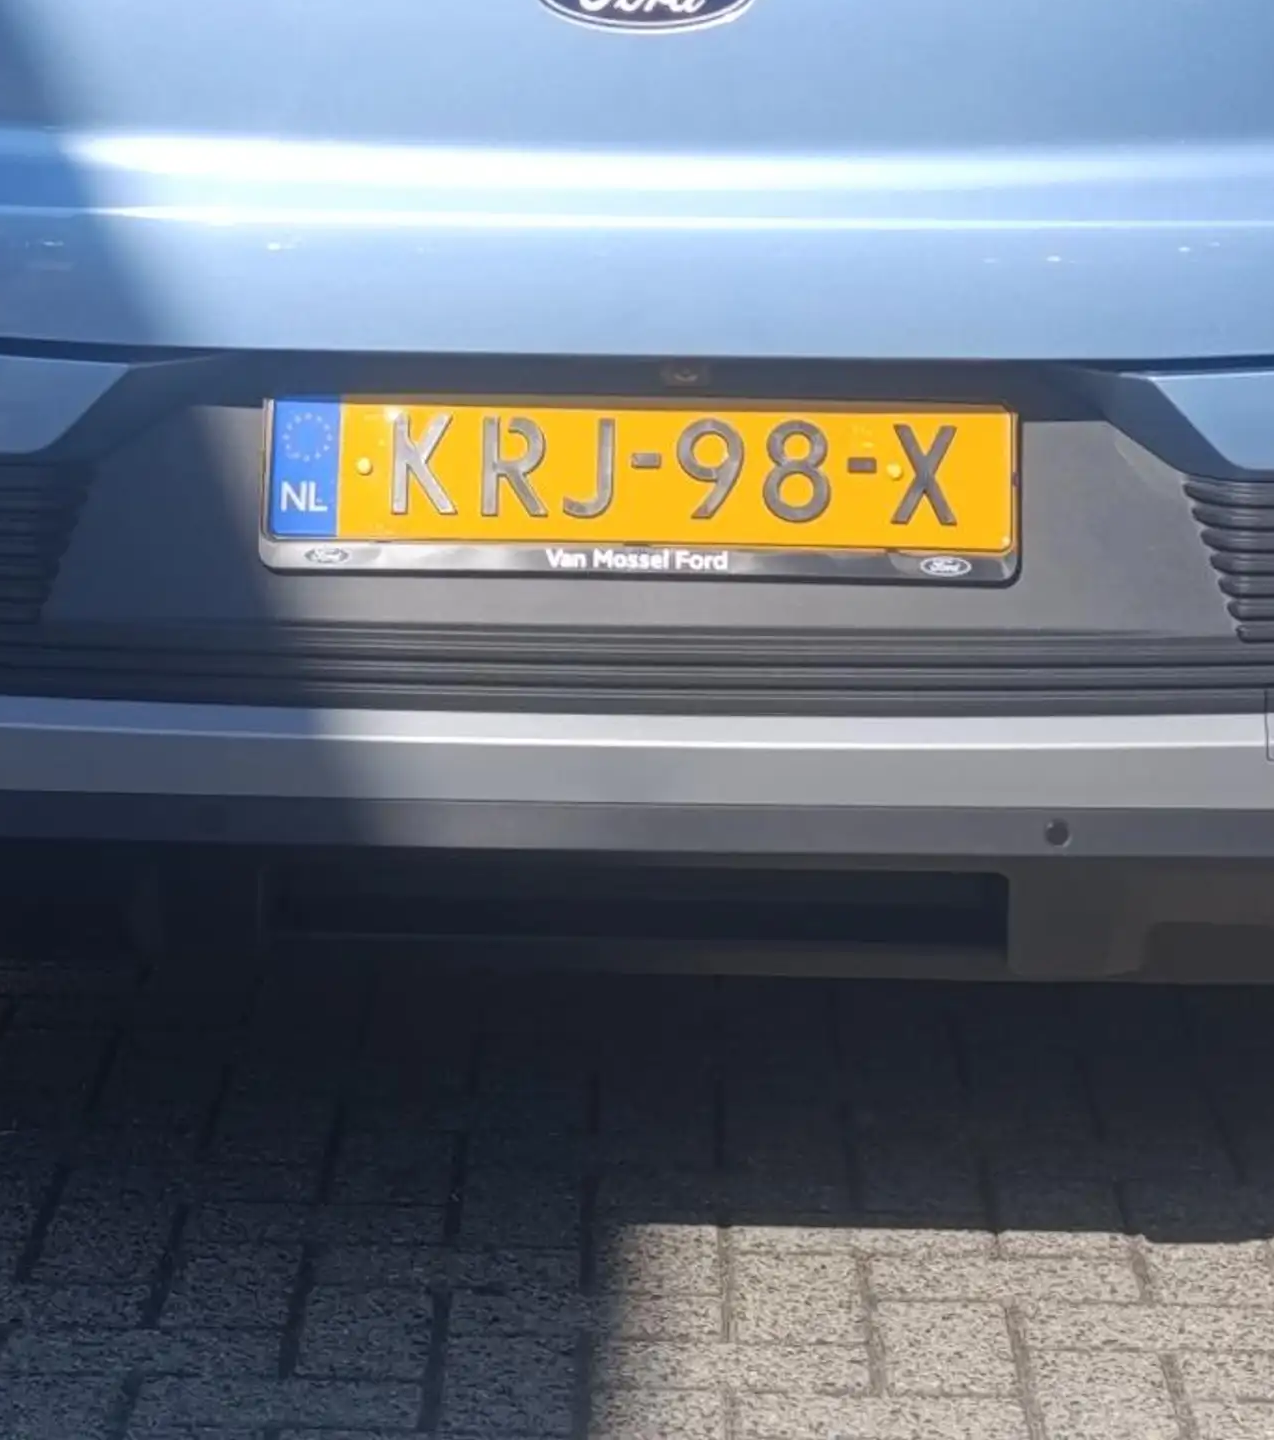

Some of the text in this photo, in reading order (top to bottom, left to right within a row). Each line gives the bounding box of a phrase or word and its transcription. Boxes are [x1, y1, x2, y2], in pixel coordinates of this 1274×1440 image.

[390, 412, 958, 526] KRJ-98-X
[280, 481, 328, 512] NL
[545, 548, 728, 571] Van Mossel Ford
